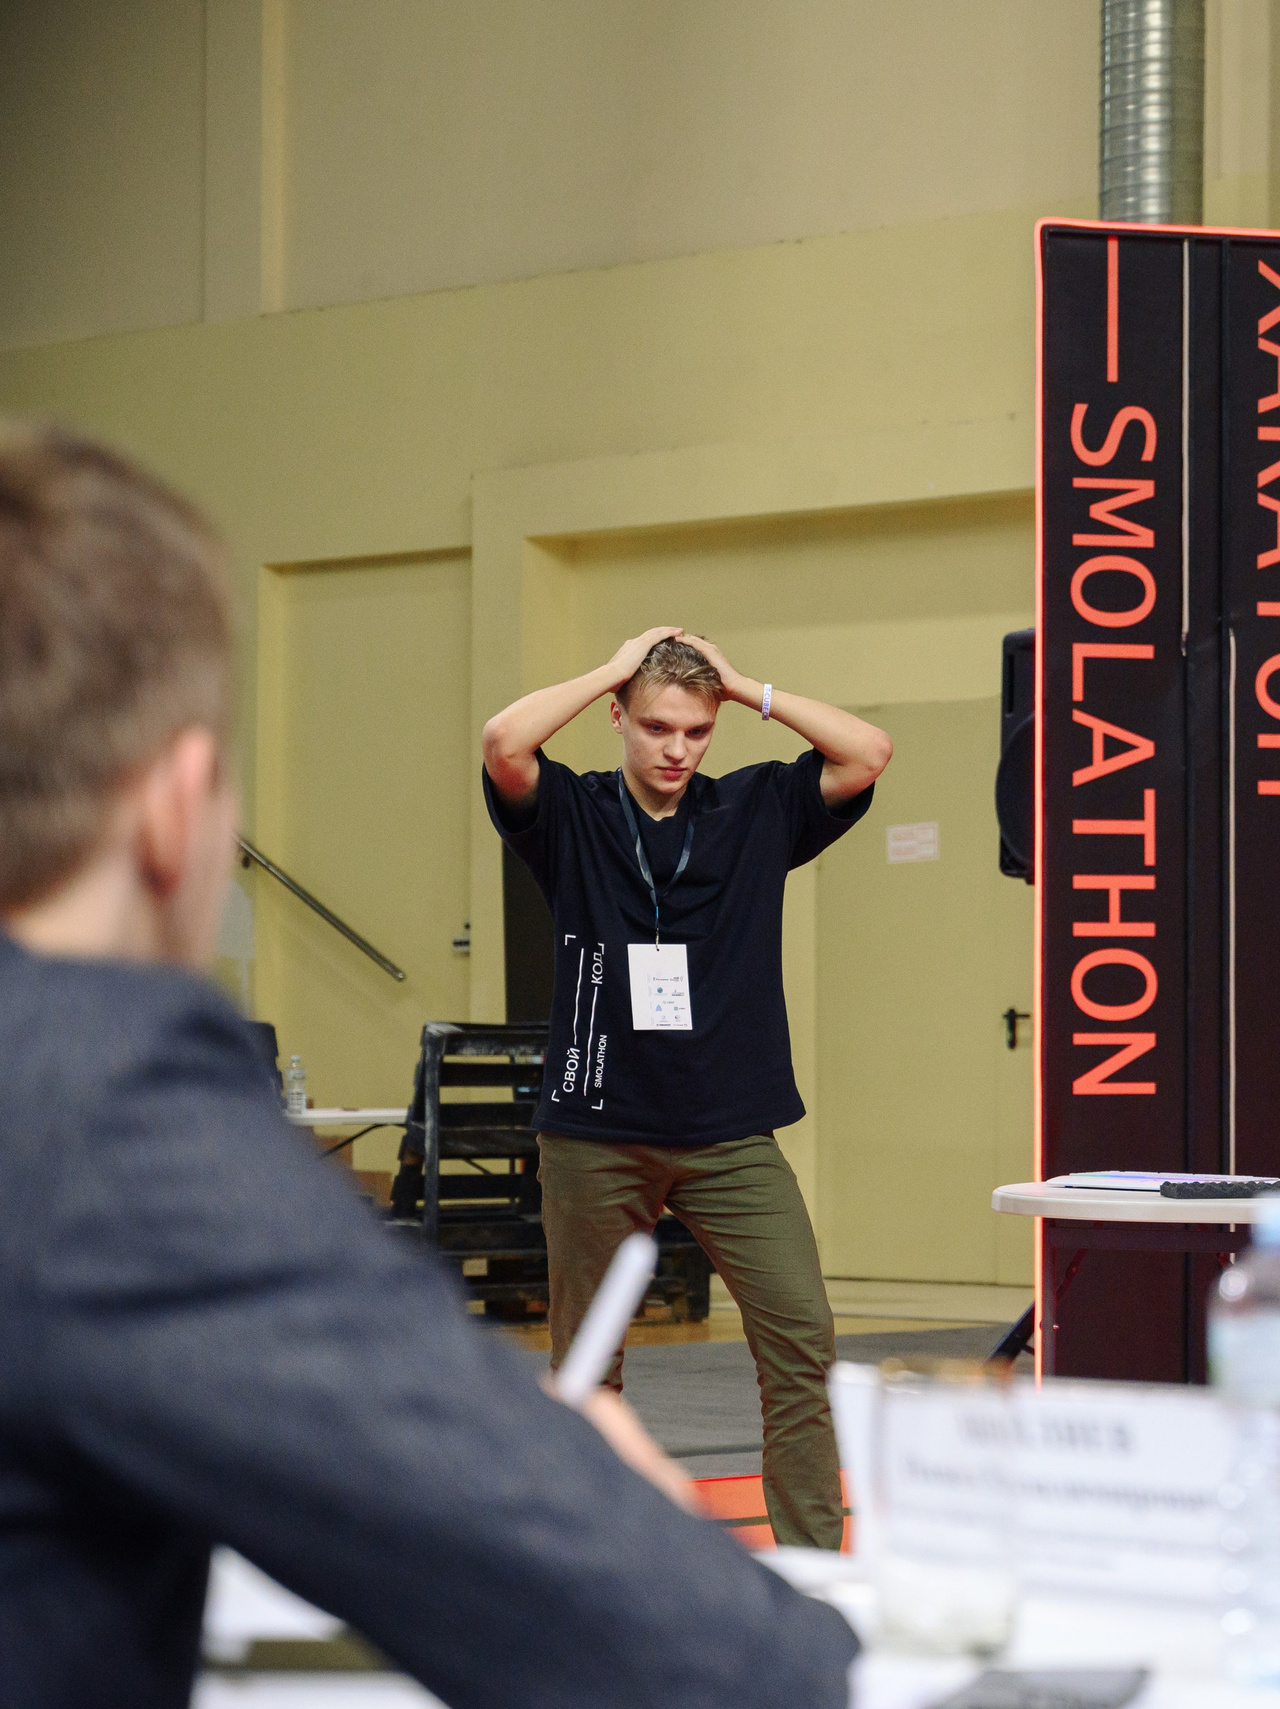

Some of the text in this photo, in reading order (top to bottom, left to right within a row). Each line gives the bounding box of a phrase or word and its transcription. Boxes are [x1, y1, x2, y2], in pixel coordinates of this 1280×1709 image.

[1069, 403, 1159, 1096] SMOLATHON
[562, 1047, 580, 1093] СВОЙ
[594, 1034, 608, 1088] SMOLATHON
